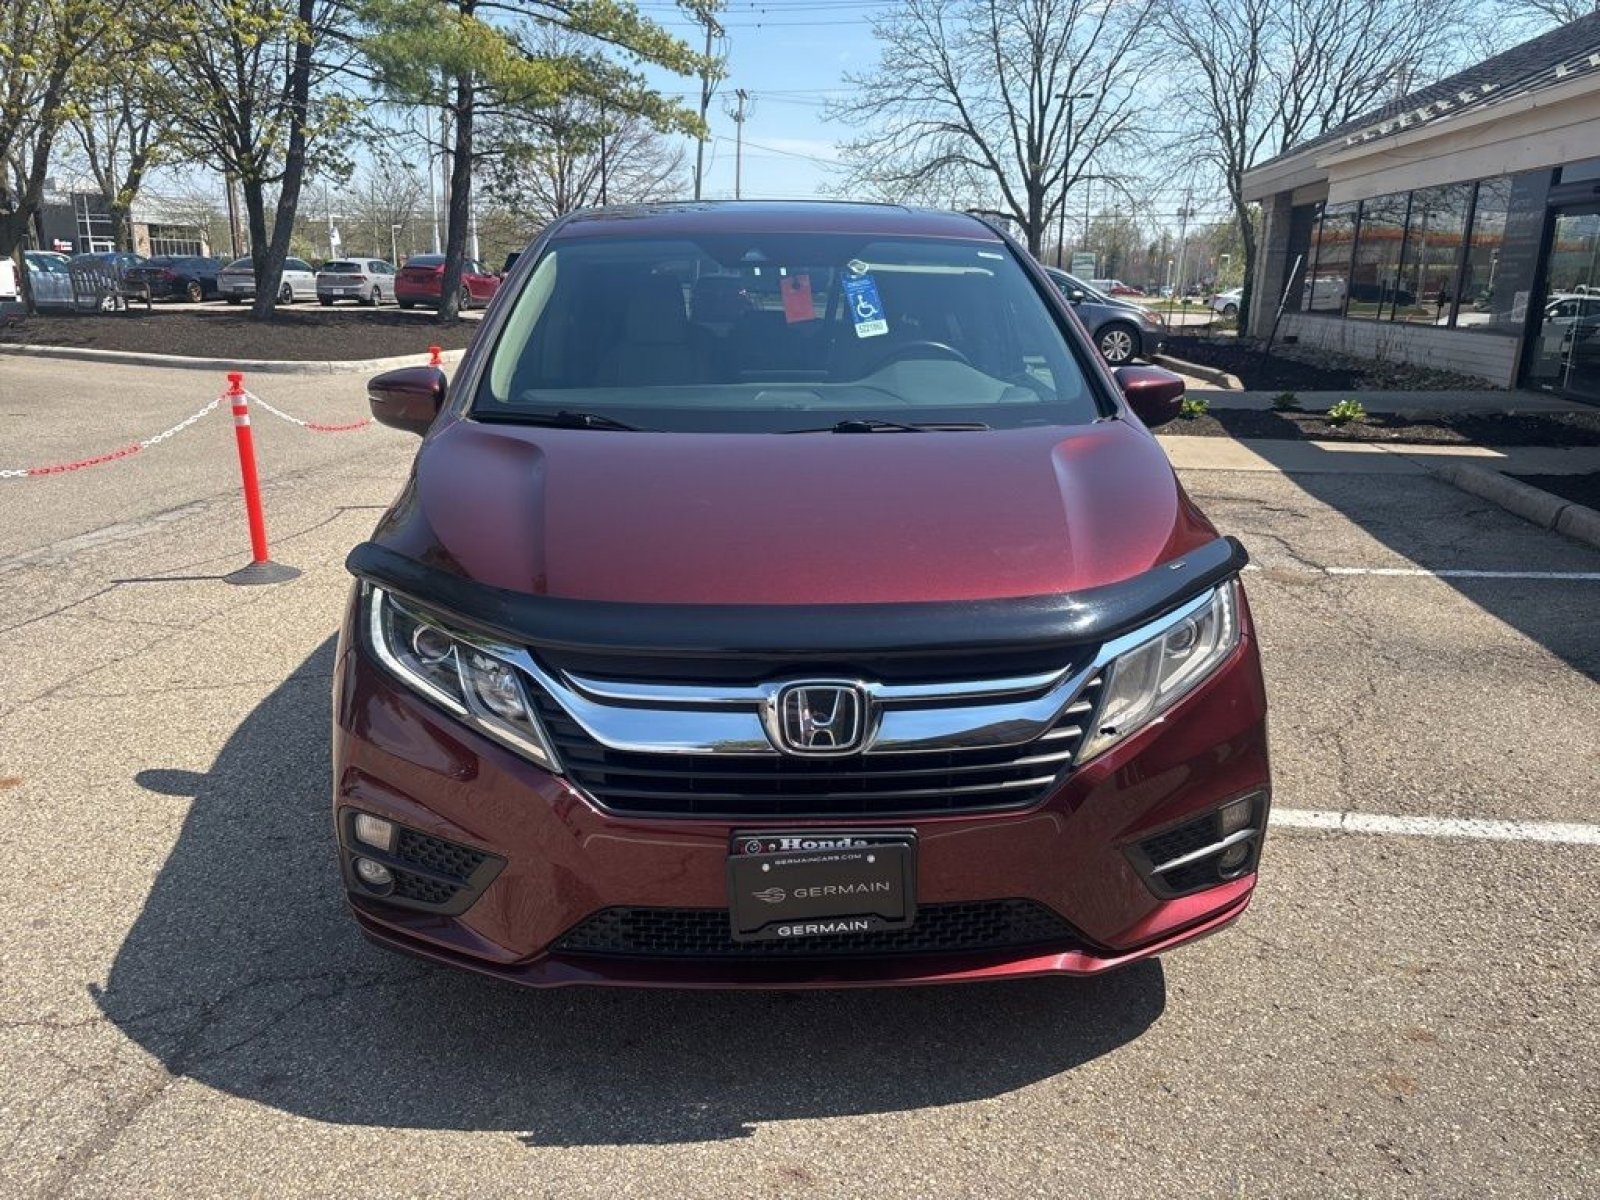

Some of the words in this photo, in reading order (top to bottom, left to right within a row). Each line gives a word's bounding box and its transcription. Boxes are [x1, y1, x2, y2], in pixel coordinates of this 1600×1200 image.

[774, 853, 862, 866] GERMAINCARS.COM
[793, 881, 890, 898] GERMAIN
[777, 920, 868, 937] GERMAIN
